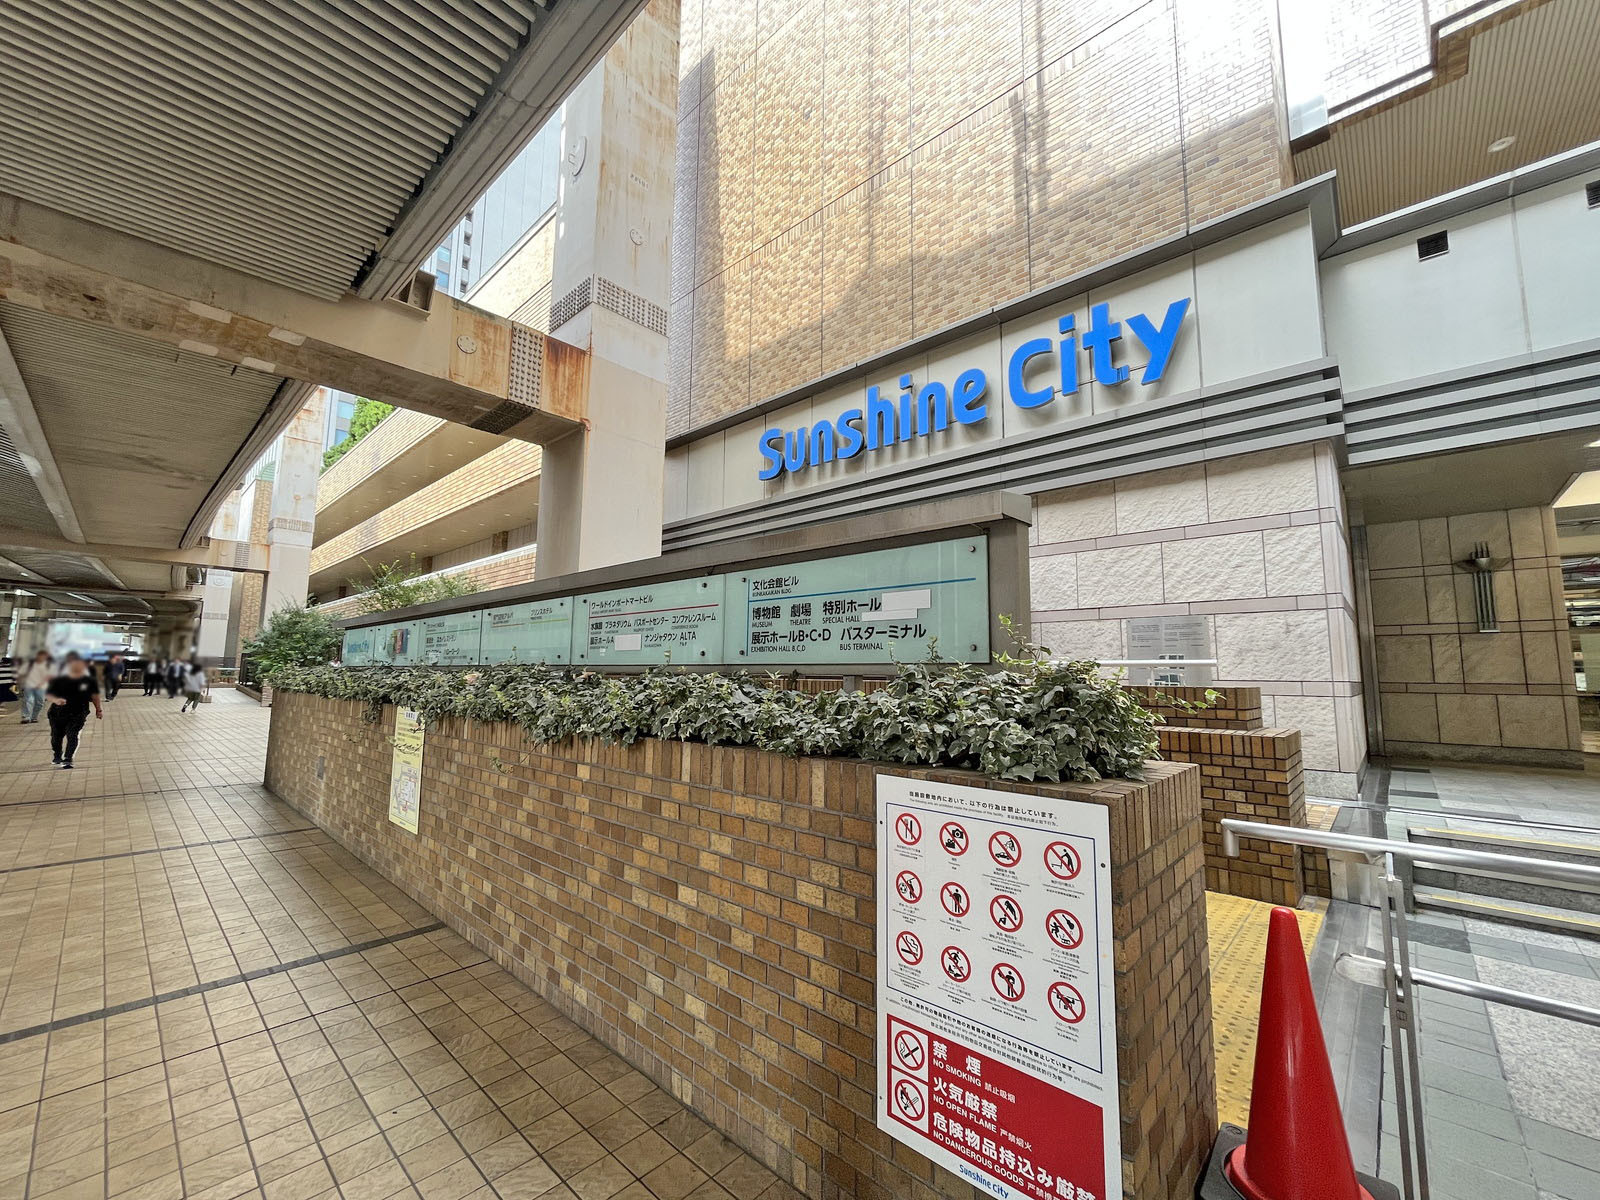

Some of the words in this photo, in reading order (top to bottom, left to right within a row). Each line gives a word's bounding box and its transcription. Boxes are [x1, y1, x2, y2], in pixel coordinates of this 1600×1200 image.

[758, 367, 988, 482] Sunshine
[1008, 296, 1192, 410] City
[752, 575, 800, 591] 文化会館ビル
[591, 594, 654, 609] ワールドインポートマートビル
[752, 605, 781, 620] 博物館
[790, 602, 812, 617] 劇場
[822, 597, 882, 615] 特別ホール
[790, 618, 812, 626] THEATRE
[822, 616, 844, 624] SPECIAL
[840, 623, 927, 640] バスターミナル
[679, 631, 697, 641] ALTA
[839, 643, 851, 651] BUS
[853, 642, 883, 650] TERMINAL
[932, 1040, 948, 1060] 禁
[965, 1054, 982, 1076] 煙
[933, 1058, 944, 1069] NO
[945, 1064, 982, 1087] SMOKING
[933, 1076, 998, 1121] 火気厳禁
[933, 1094, 944, 1105] NO
[945, 1100, 968, 1118] OPEN
[969, 1112, 997, 1133] FLAME
[933, 1129, 944, 1141] NO
[945, 1136, 993, 1169] DANGEROUS
[994, 1164, 1025, 1187] GOODS
[959, 1164, 992, 1190] Sunshine
[992, 1183, 1009, 1199] City
